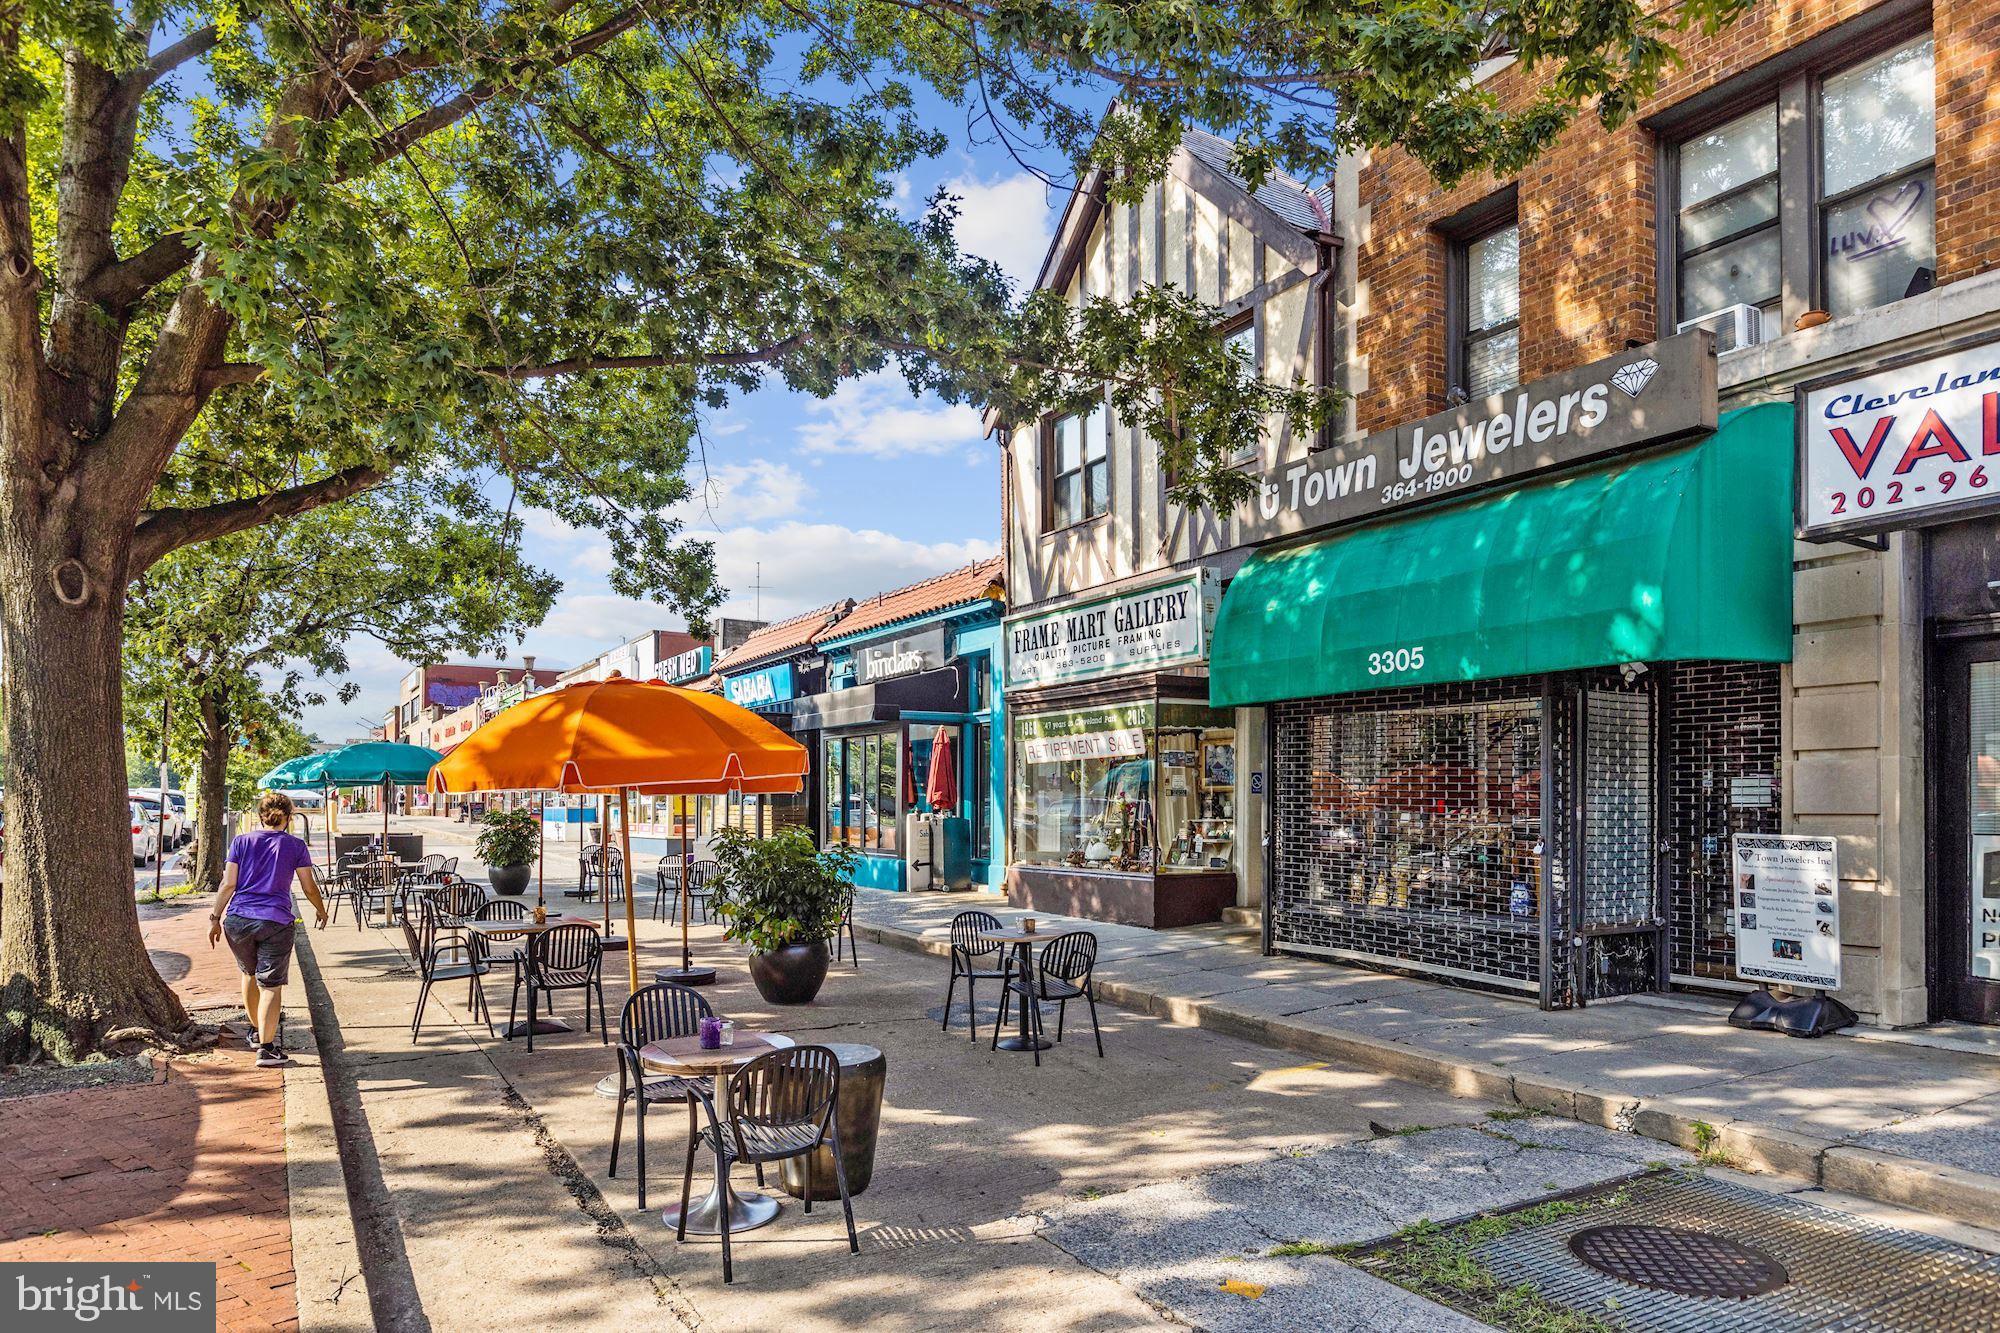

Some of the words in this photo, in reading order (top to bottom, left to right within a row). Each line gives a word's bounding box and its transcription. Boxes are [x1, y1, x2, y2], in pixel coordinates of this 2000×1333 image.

[1286, 454, 1377, 511] Town
[1400, 383, 1608, 479] Jewelers
[1381, 463, 1473, 504] 364-1900
[1831, 465, 1988, 515] 202-96
[1014, 621, 1060, 653] FRAME
[1066, 611, 1107, 643] MART
[1114, 590, 1189, 633] GALLERY
[866, 640, 924, 680] bindaas
[1034, 647, 1067, 662] QUALITY
[1073, 638, 1111, 655] PICTURE
[1117, 628, 1162, 646] FRAMING
[1129, 640, 1182, 656] SUPPLIES
[1368, 646, 1425, 675] 3305
[680, 650, 698, 676] MED
[730, 671, 775, 703] SABABA
[1127, 708, 1146, 726] 2015
[1028, 738, 1101, 760] RETIREMENT
[1108, 733, 1141, 752] SALE
[1755, 853, 1778, 862] Town
[1780, 855, 1815, 864] Jewelers
[1817, 857, 1832, 866] Inc
